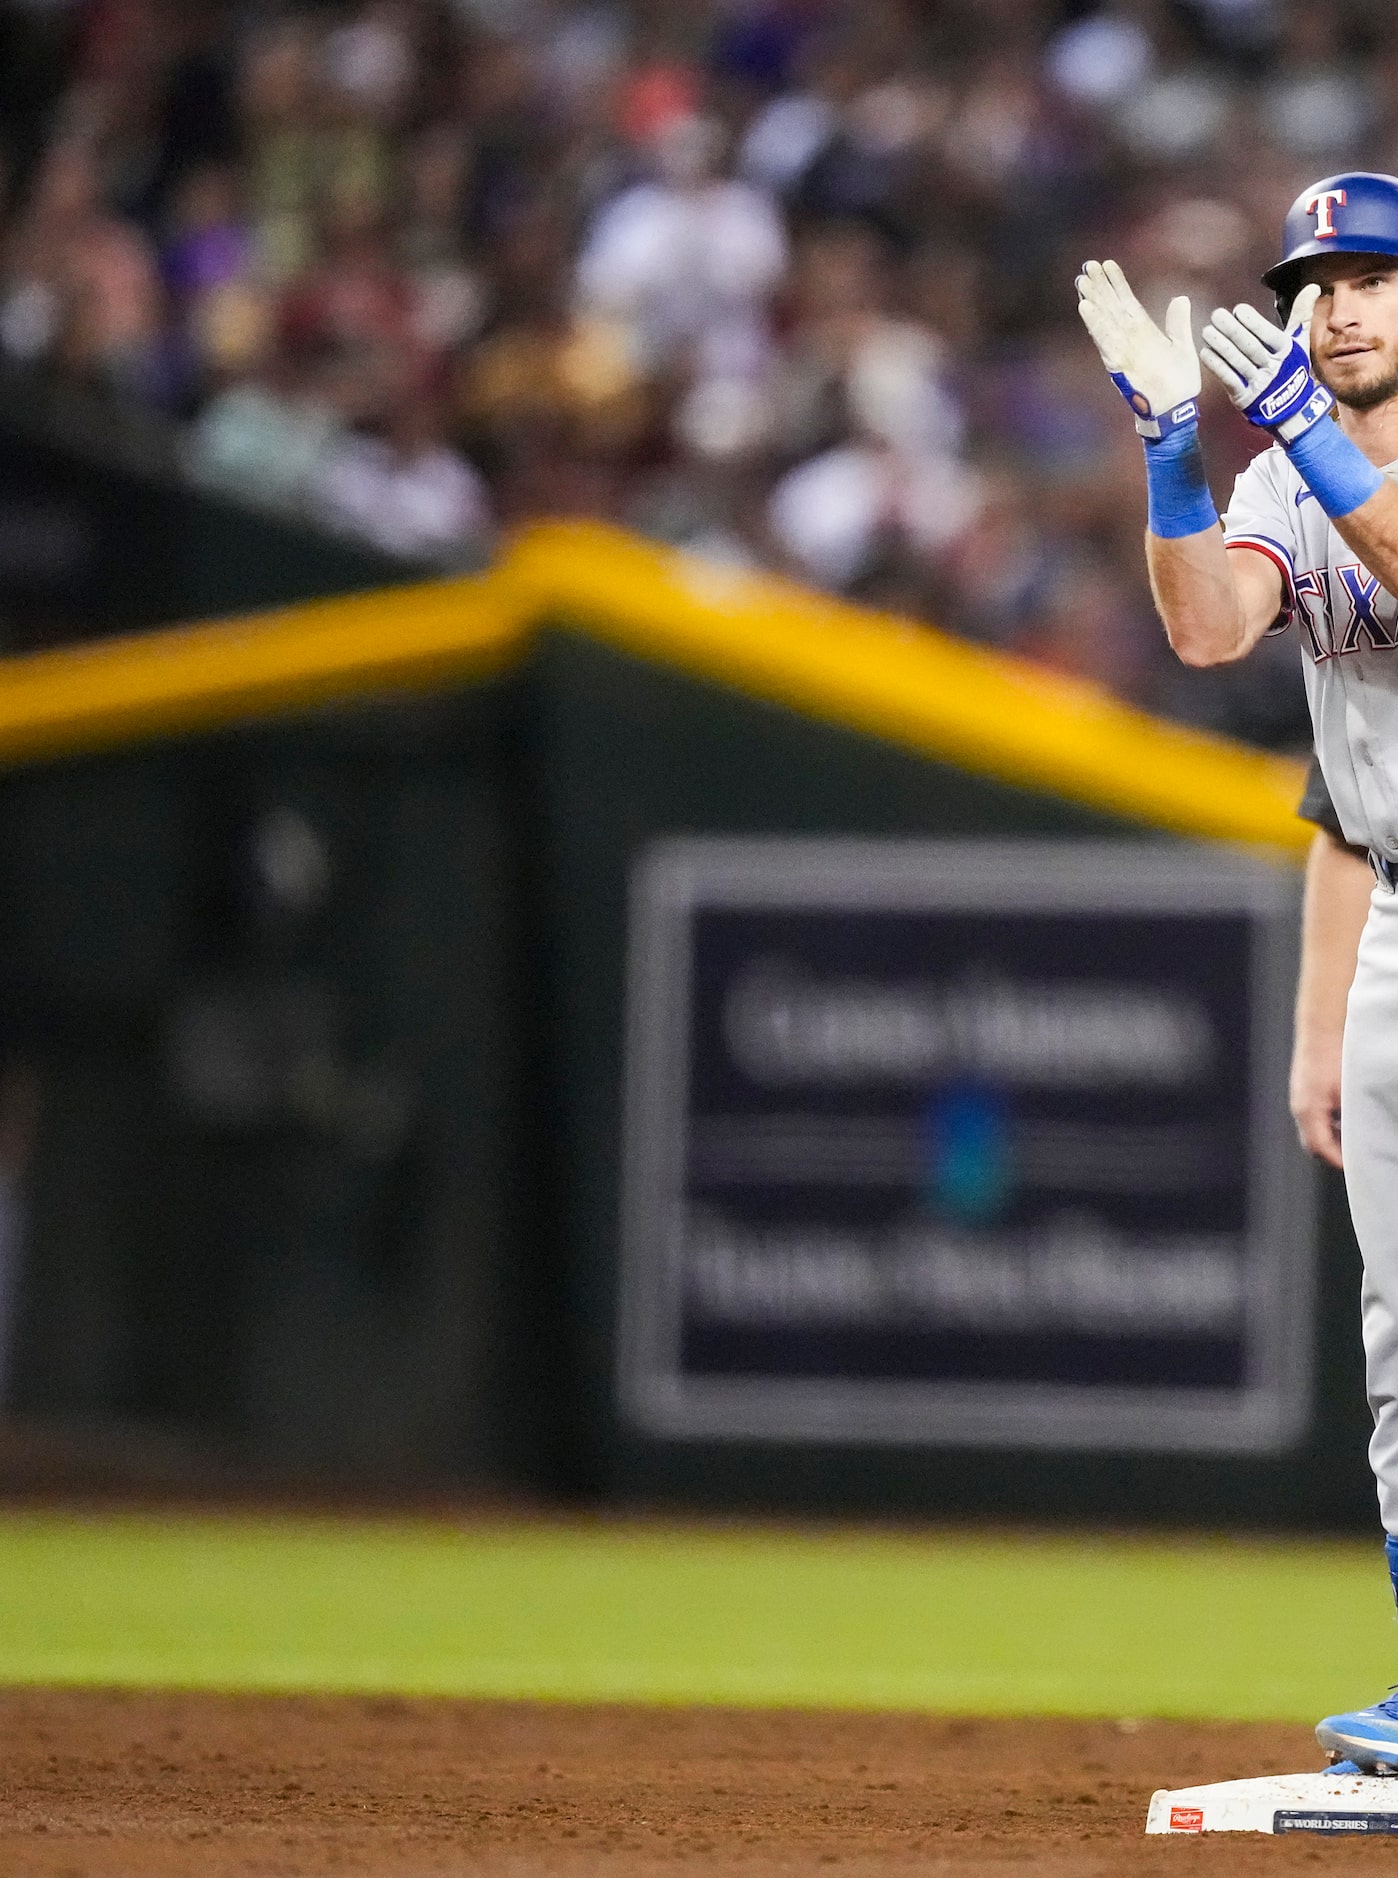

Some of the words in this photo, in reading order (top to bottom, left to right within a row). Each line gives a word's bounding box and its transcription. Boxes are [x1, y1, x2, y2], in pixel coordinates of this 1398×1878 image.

[1305, 189, 1347, 239] T
[1262, 368, 1306, 417] Franklin
[1294, 1819, 1332, 1829] WORLD
[1331, 1820, 1369, 1830] SERIES
